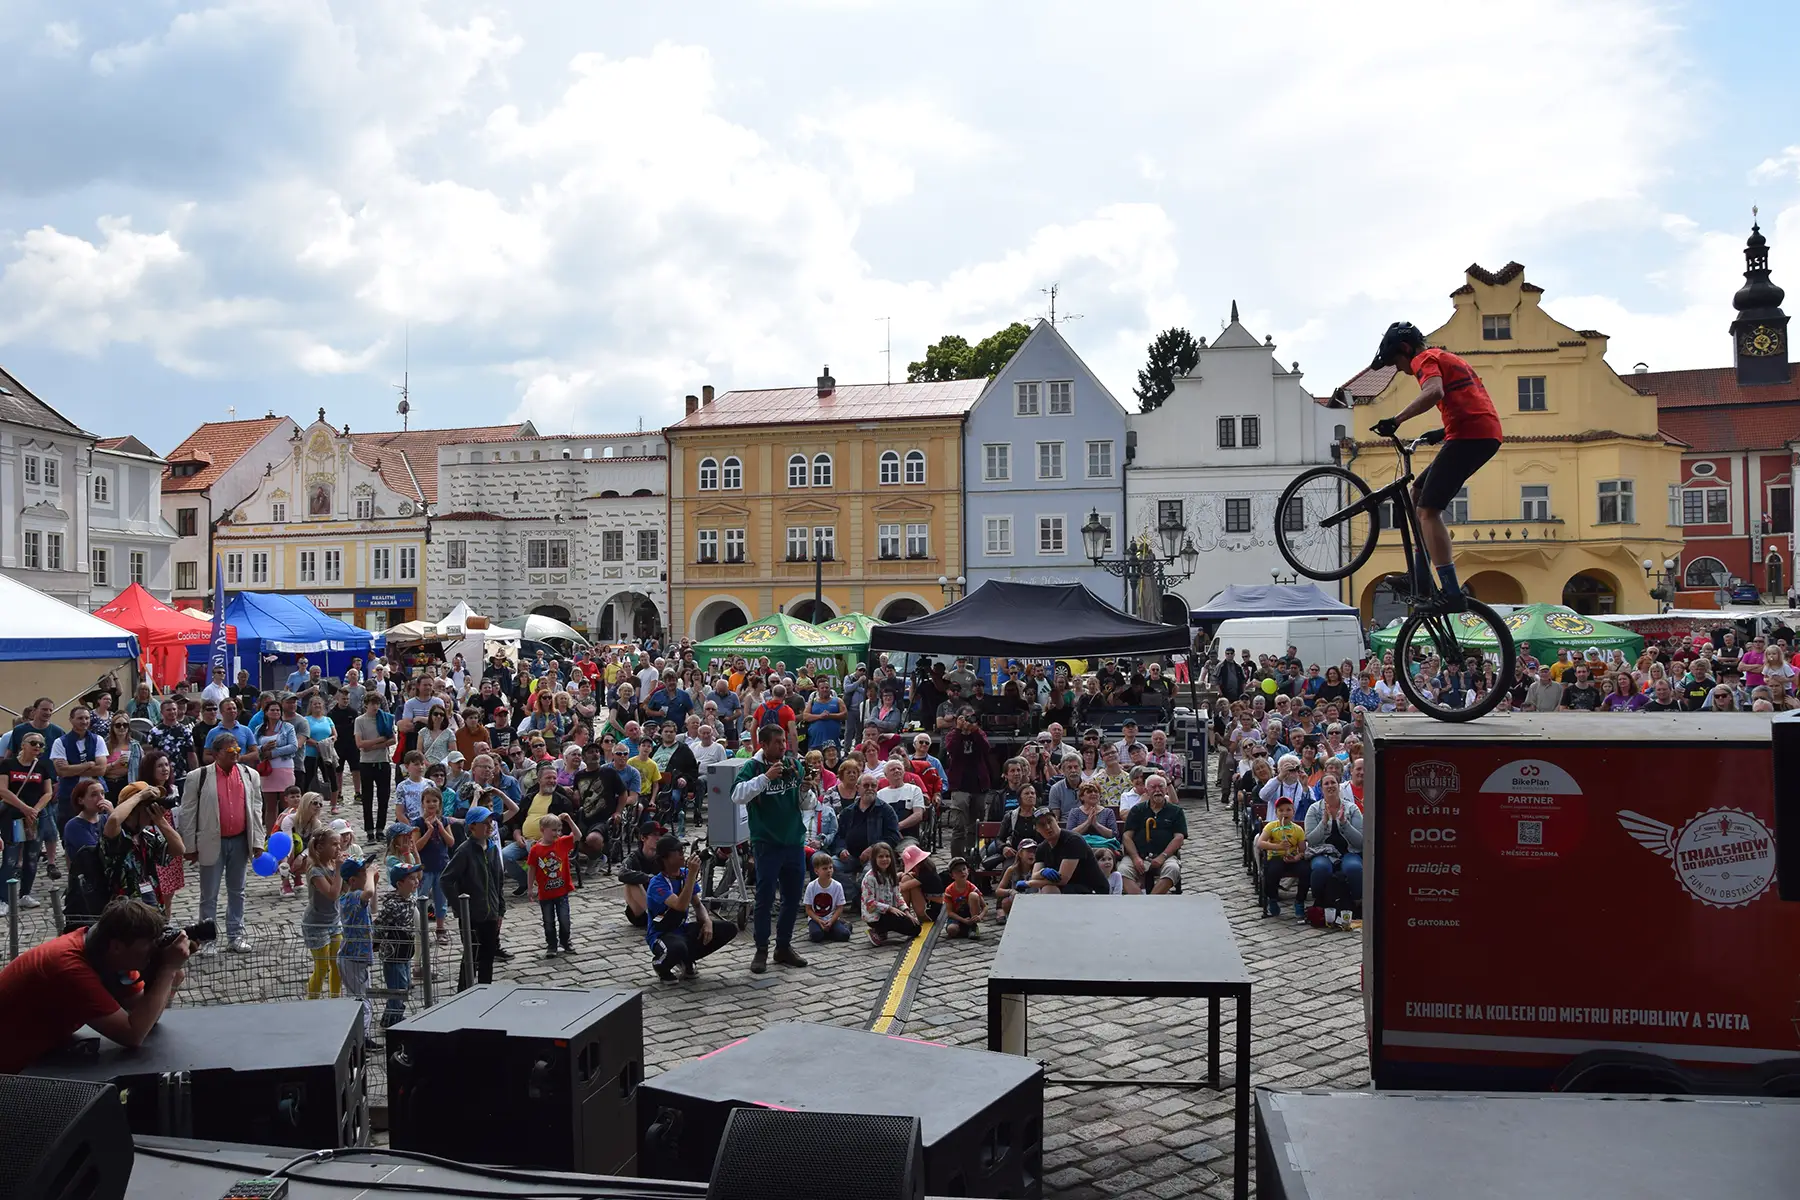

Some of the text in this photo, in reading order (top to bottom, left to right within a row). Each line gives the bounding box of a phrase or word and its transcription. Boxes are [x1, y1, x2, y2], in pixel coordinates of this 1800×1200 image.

[177, 630, 200, 641] Cocktail
[1512, 778, 1550, 786] BikePlan
[1507, 796, 1554, 804] PARTNER
[1679, 838, 1768, 862] TRIALSHOW
[1682, 862, 1697, 871] DO
[1698, 851, 1757, 869] IMPOSSIBLE
[1406, 861, 1450, 875] maloja
[1408, 886, 1460, 896] LEZYNE
[1687, 874, 1765, 899] FUN ON OBSTACLES
[1417, 919, 1460, 927] GATORADE
[1405, 1001, 1750, 1031] EXHIBICE NA KOLECH OD MISTRU REPUBLIKY A SVETA
